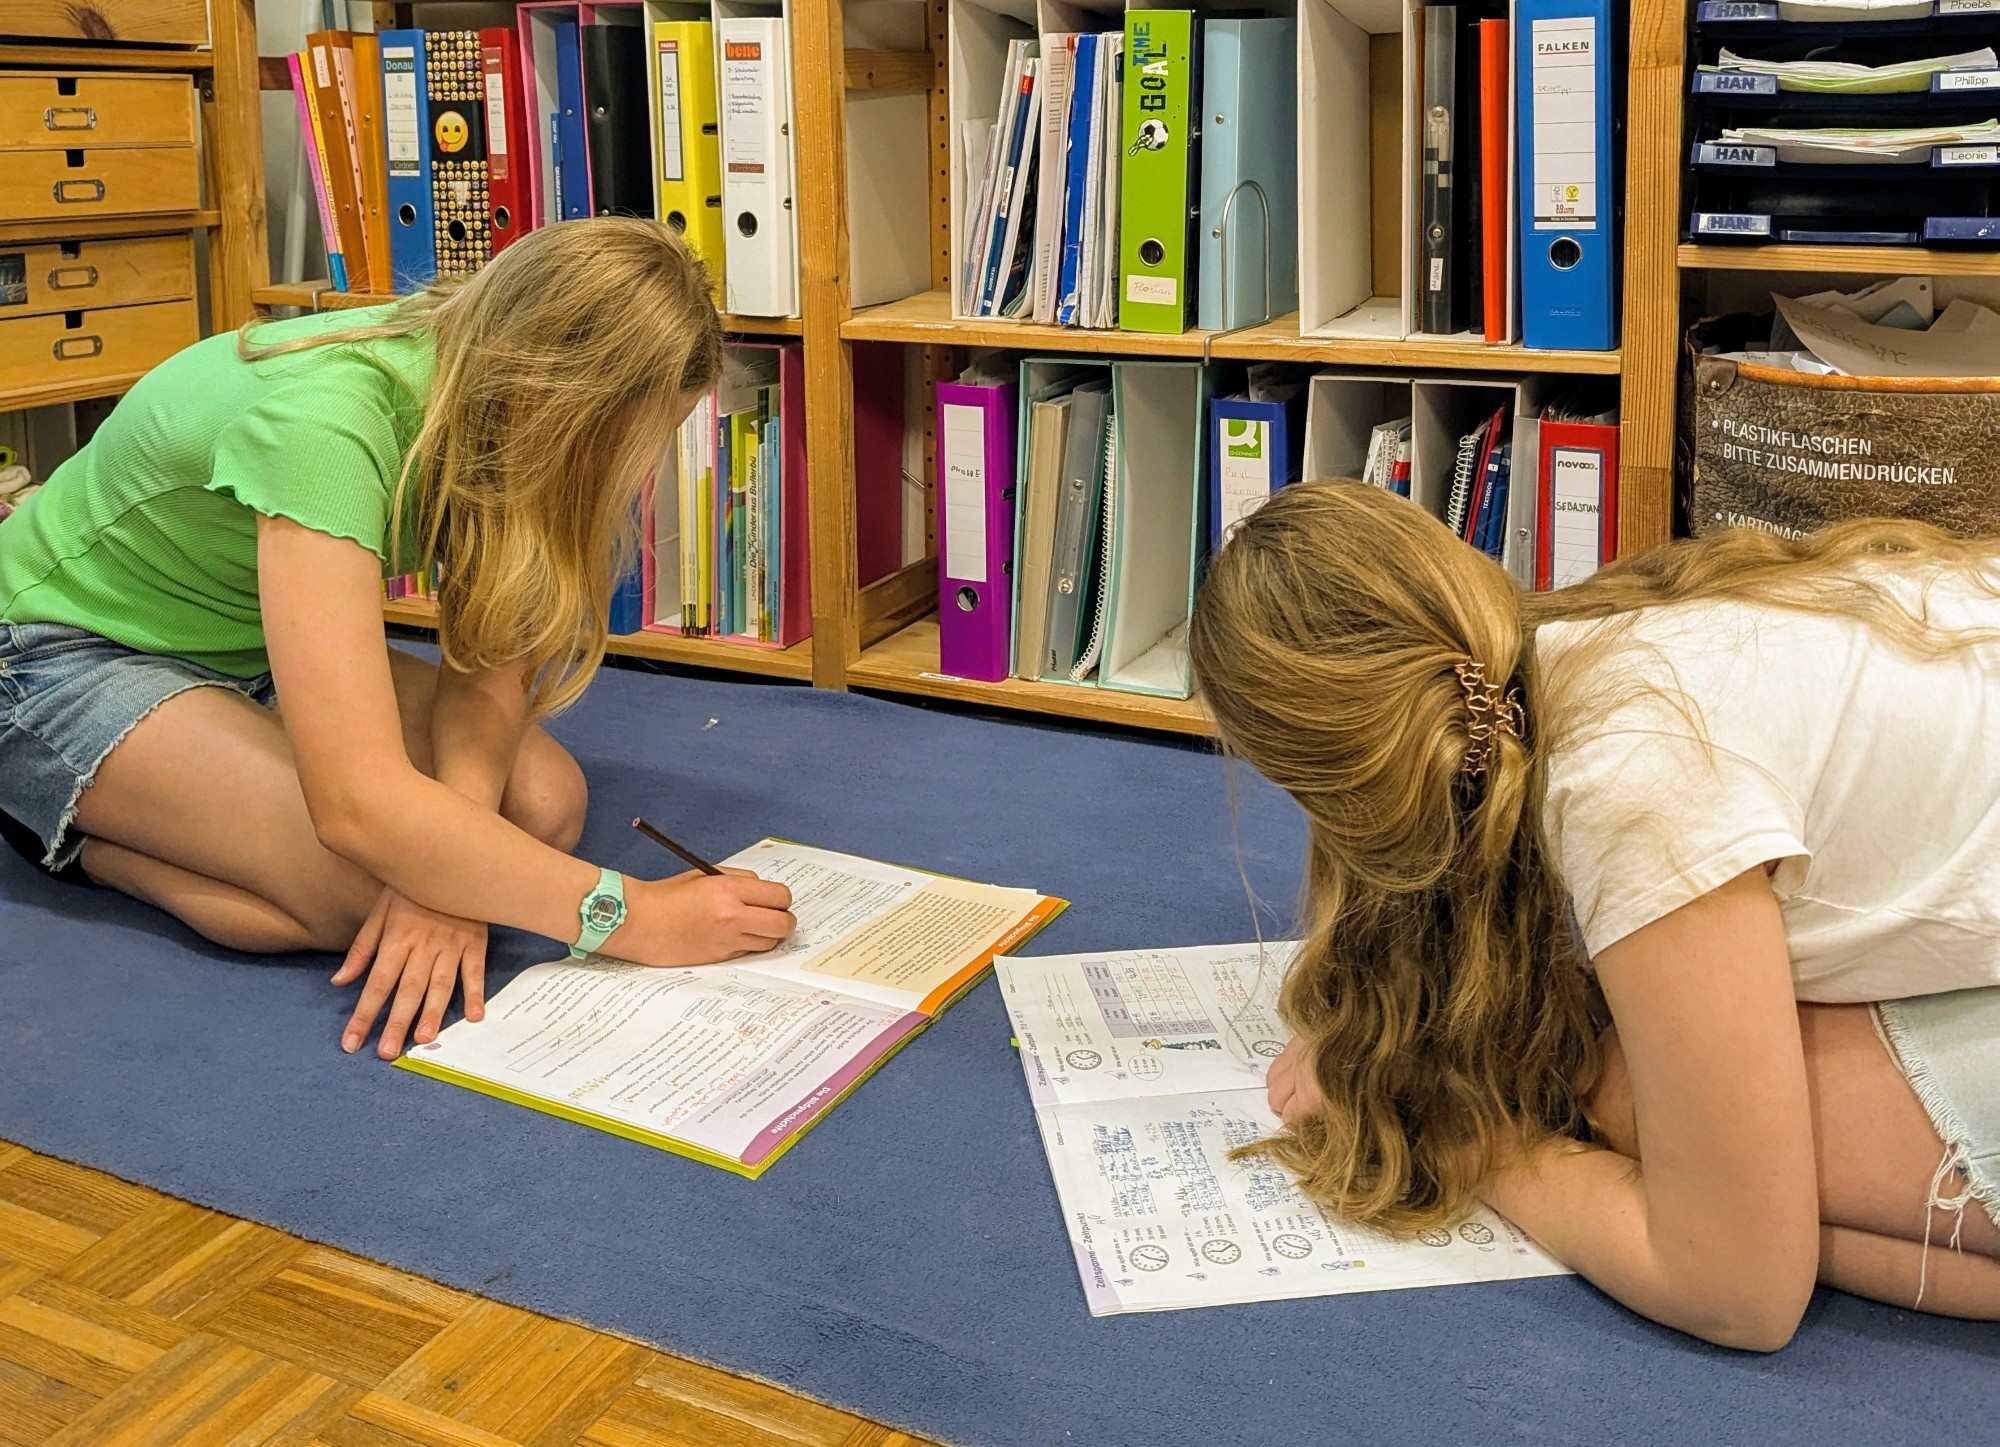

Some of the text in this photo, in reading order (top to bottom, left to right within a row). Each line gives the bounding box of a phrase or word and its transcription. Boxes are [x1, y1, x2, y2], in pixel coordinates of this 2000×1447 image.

[1717, 5, 1757, 17] HAN
[726, 39, 761, 57] bene
[1132, 21, 1150, 66] TIME
[1538, 41, 1589, 52] FALKEN
[385, 60, 414, 71] Donau
[1140, 42, 1168, 112] GOAL
[1716, 77, 1755, 90] HAN
[1715, 148, 1754, 161] HAN
[1951, 150, 1988, 161] Leonie
[1710, 218, 1750, 230] HAN
[1133, 281, 1172, 296] Florian
[1723, 420, 1872, 456] PLASTIKFLASCHEN
[1229, 449, 1259, 457] Q-CONNECT
[1723, 443, 1958, 485] BITTE ZUSAMMENDRÜCKEN.
[1482, 481, 1493, 510] TEXTBOOK
[1554, 501, 1600, 513] SEBASTIAN
[747, 514, 758, 551] Kinder
[1024, 1031, 1049, 1086] Zeitspanne Zeitpunkt
[767, 1086, 831, 1134] Die Bildgeschichte
[1076, 1211, 1107, 1288] Zeitspanne Zeitpunkt
